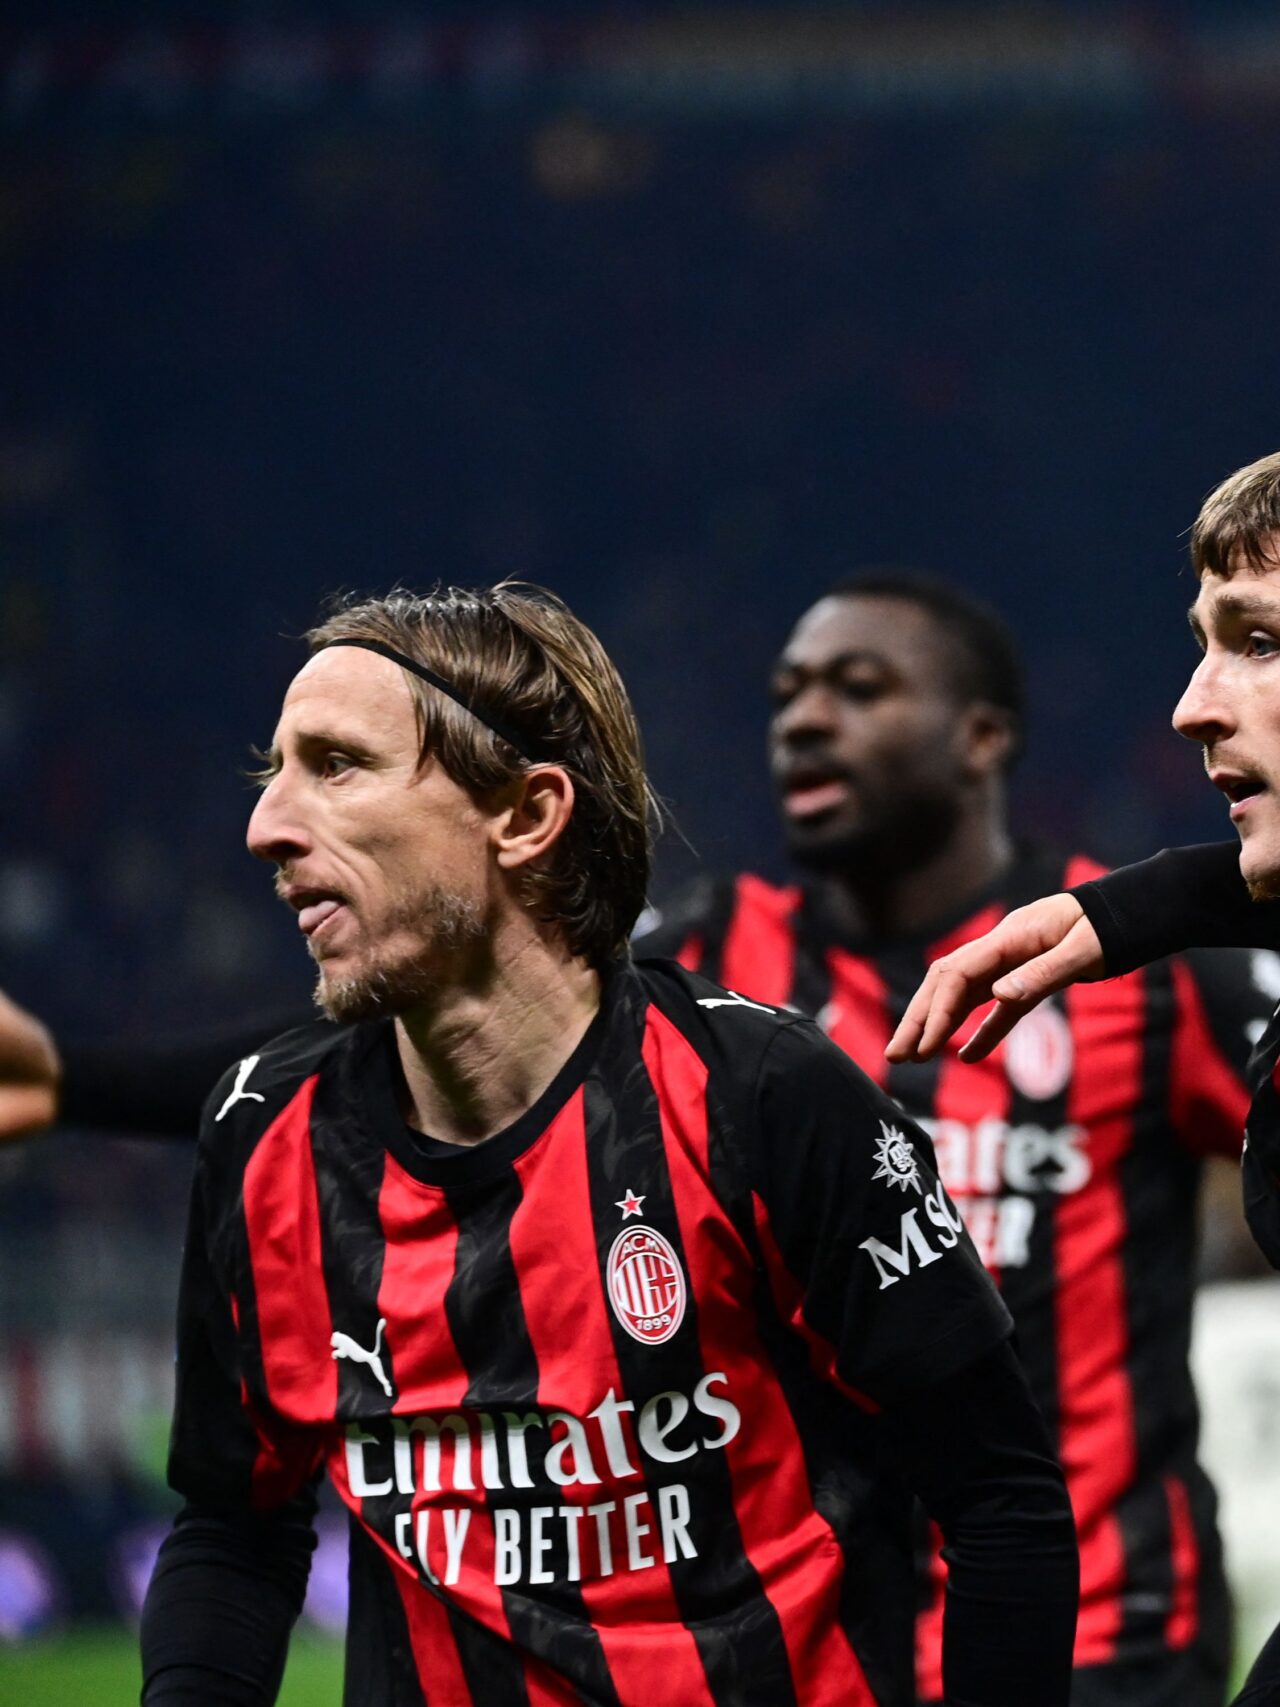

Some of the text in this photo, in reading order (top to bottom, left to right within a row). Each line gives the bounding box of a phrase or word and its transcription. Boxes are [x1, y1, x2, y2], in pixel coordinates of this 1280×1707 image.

[620, 1235, 661, 1261] ACM
[635, 1313, 673, 1331] 1899
[345, 1372, 741, 1498] Emirates
[493, 1484, 699, 1586] BETTER
